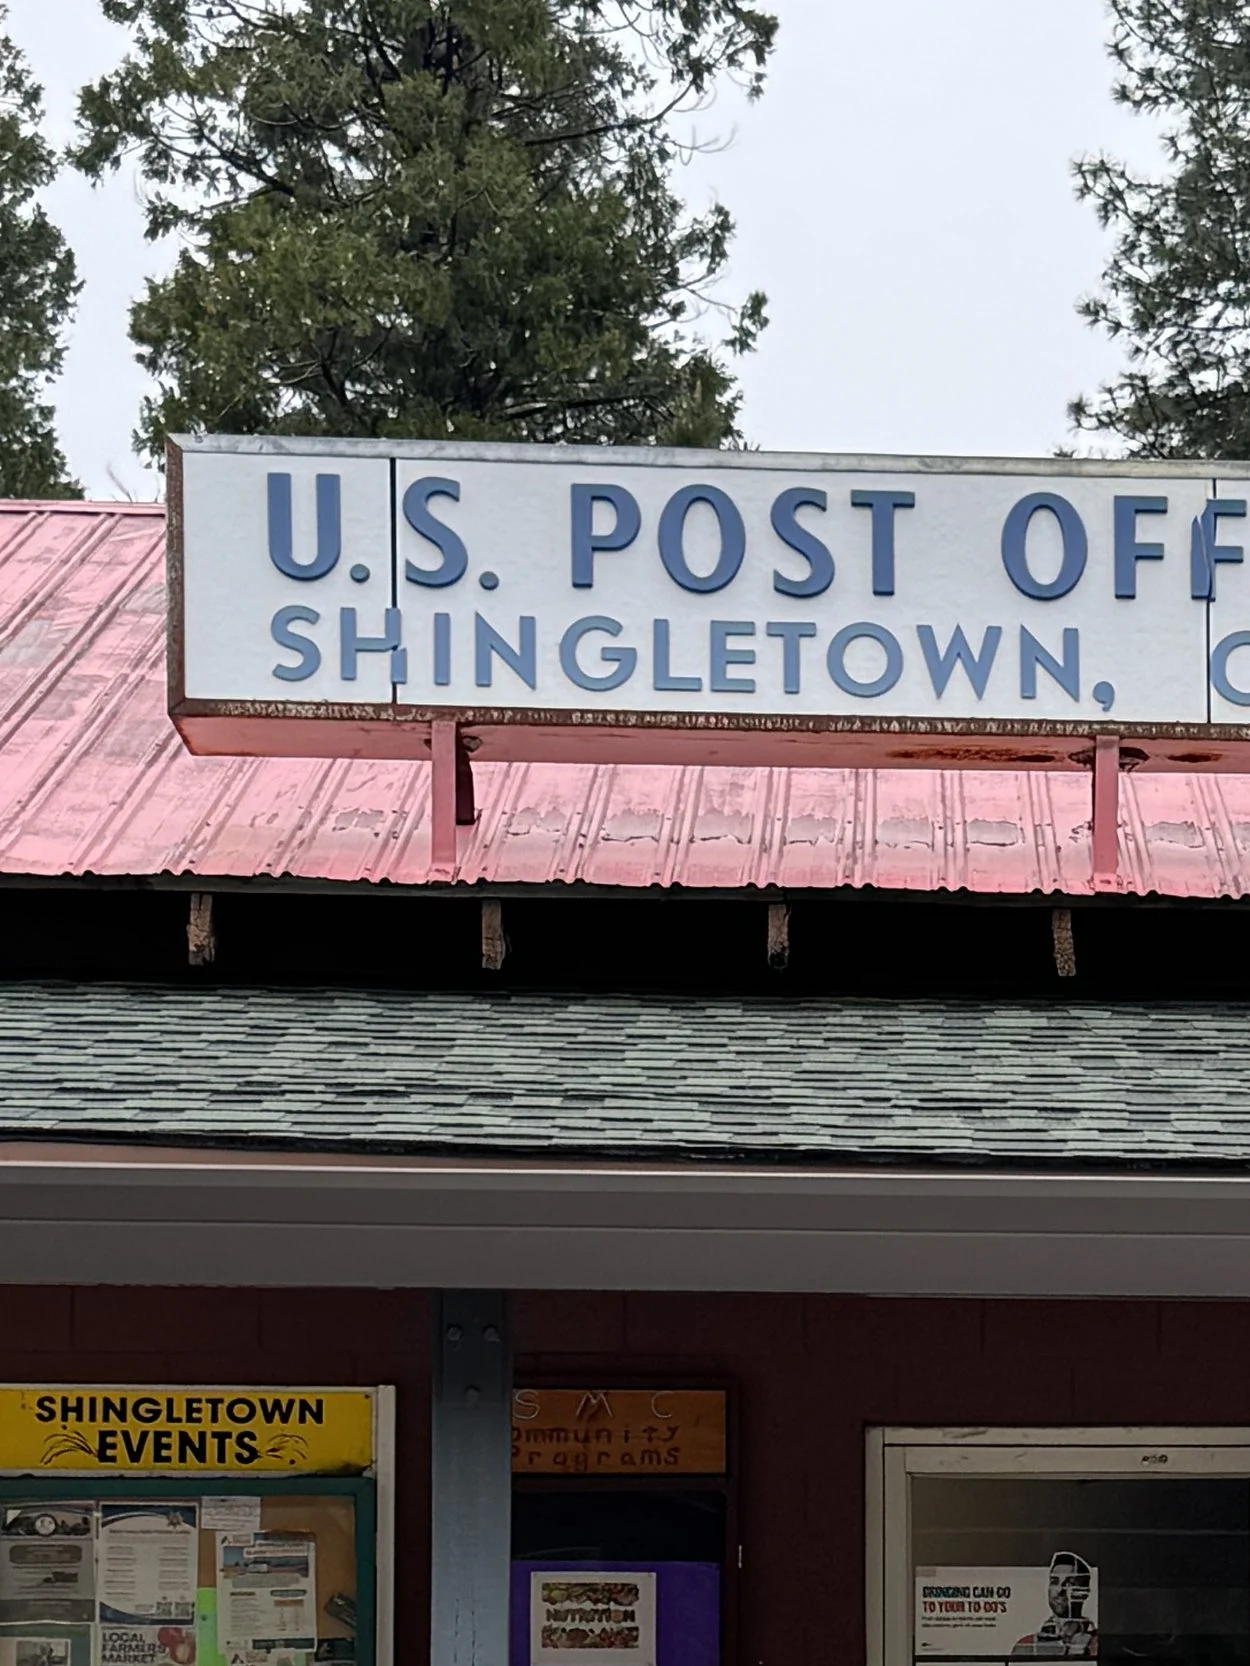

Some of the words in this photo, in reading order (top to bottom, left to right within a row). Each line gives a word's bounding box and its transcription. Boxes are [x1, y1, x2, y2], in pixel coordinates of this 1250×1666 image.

[266, 471, 499, 590] U.S.
[571, 482, 917, 597] POST
[270, 604, 1116, 713] SHINGLETOWN,
[34, 1395, 324, 1425] SHINGLETOWN
[97, 1429, 262, 1466] EVENTS
[101, 1643, 166, 1654] FARMERS
[102, 1632, 145, 1643] LOCAL
[101, 1653, 156, 1664] MARKET
